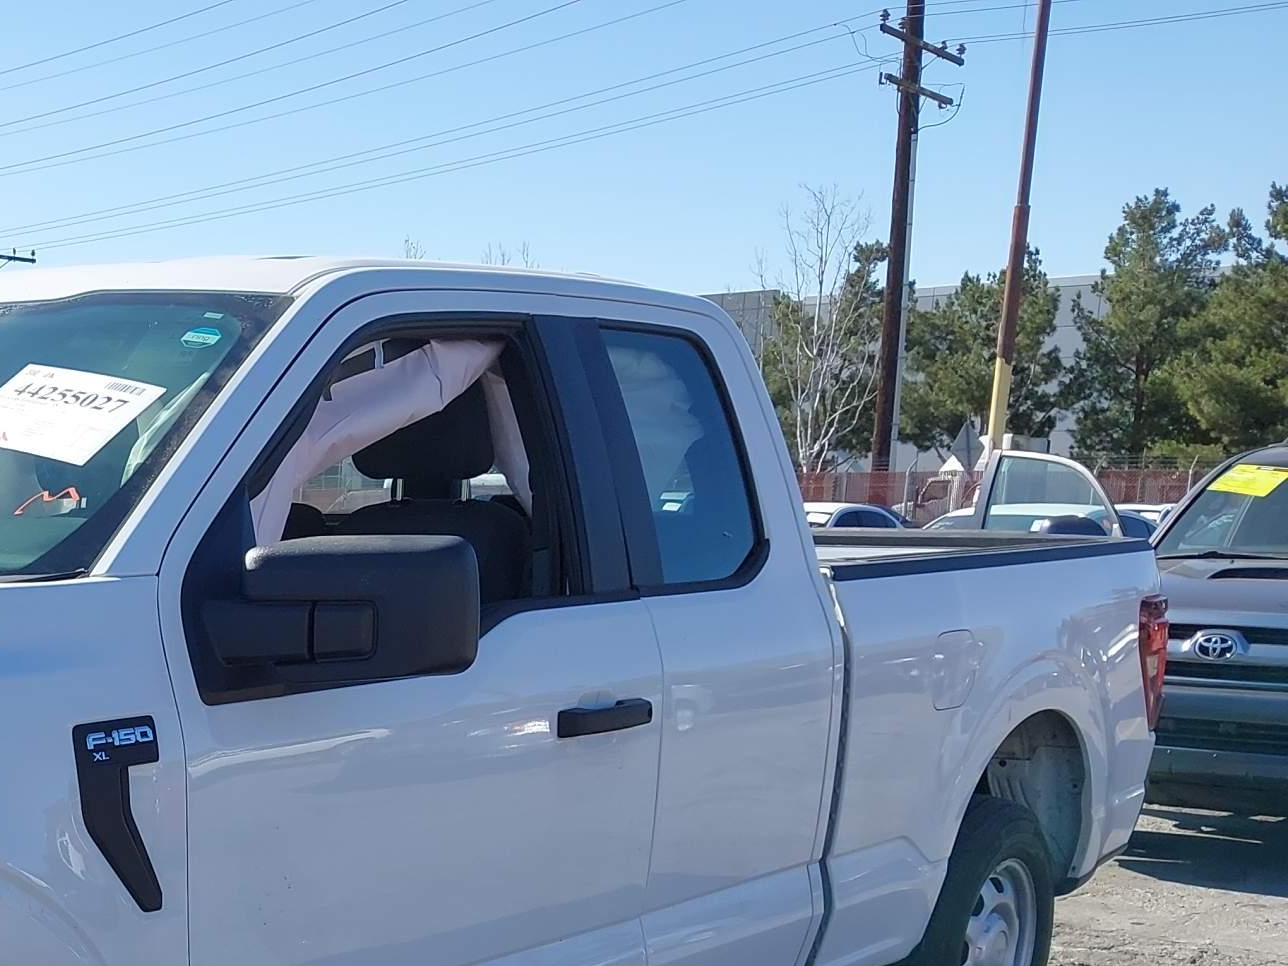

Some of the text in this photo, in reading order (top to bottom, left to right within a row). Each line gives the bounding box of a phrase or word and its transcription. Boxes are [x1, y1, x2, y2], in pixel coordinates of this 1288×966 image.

[14, 383, 130, 413] 44255027
[87, 726, 153, 749] F-150
[92, 751, 110, 762] XL
